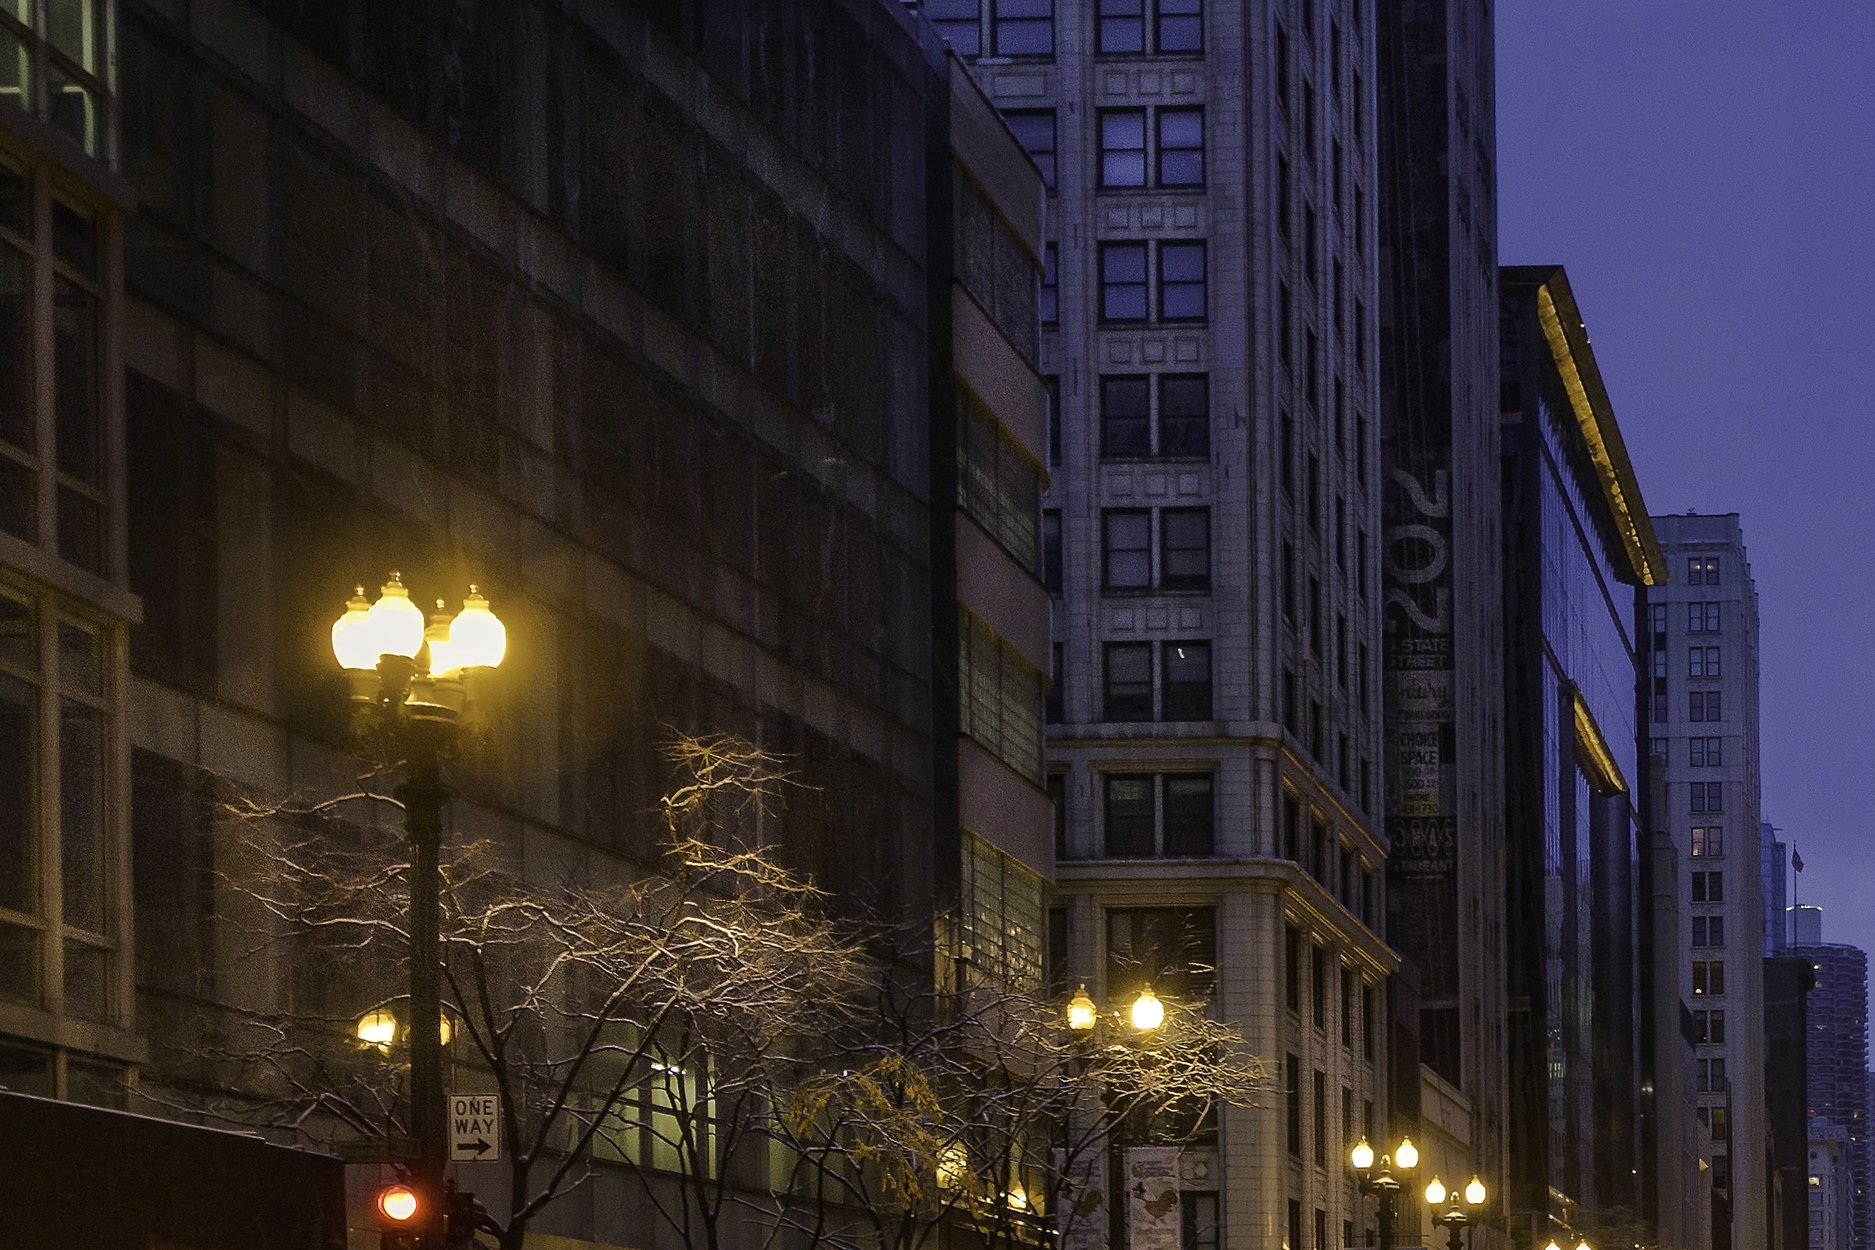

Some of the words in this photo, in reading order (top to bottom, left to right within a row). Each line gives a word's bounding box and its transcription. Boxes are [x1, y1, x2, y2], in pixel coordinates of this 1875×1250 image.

[1400, 751, 1439, 766] SPACE
[455, 1100, 493, 1115] ONE
[455, 1119, 494, 1134] WAY
